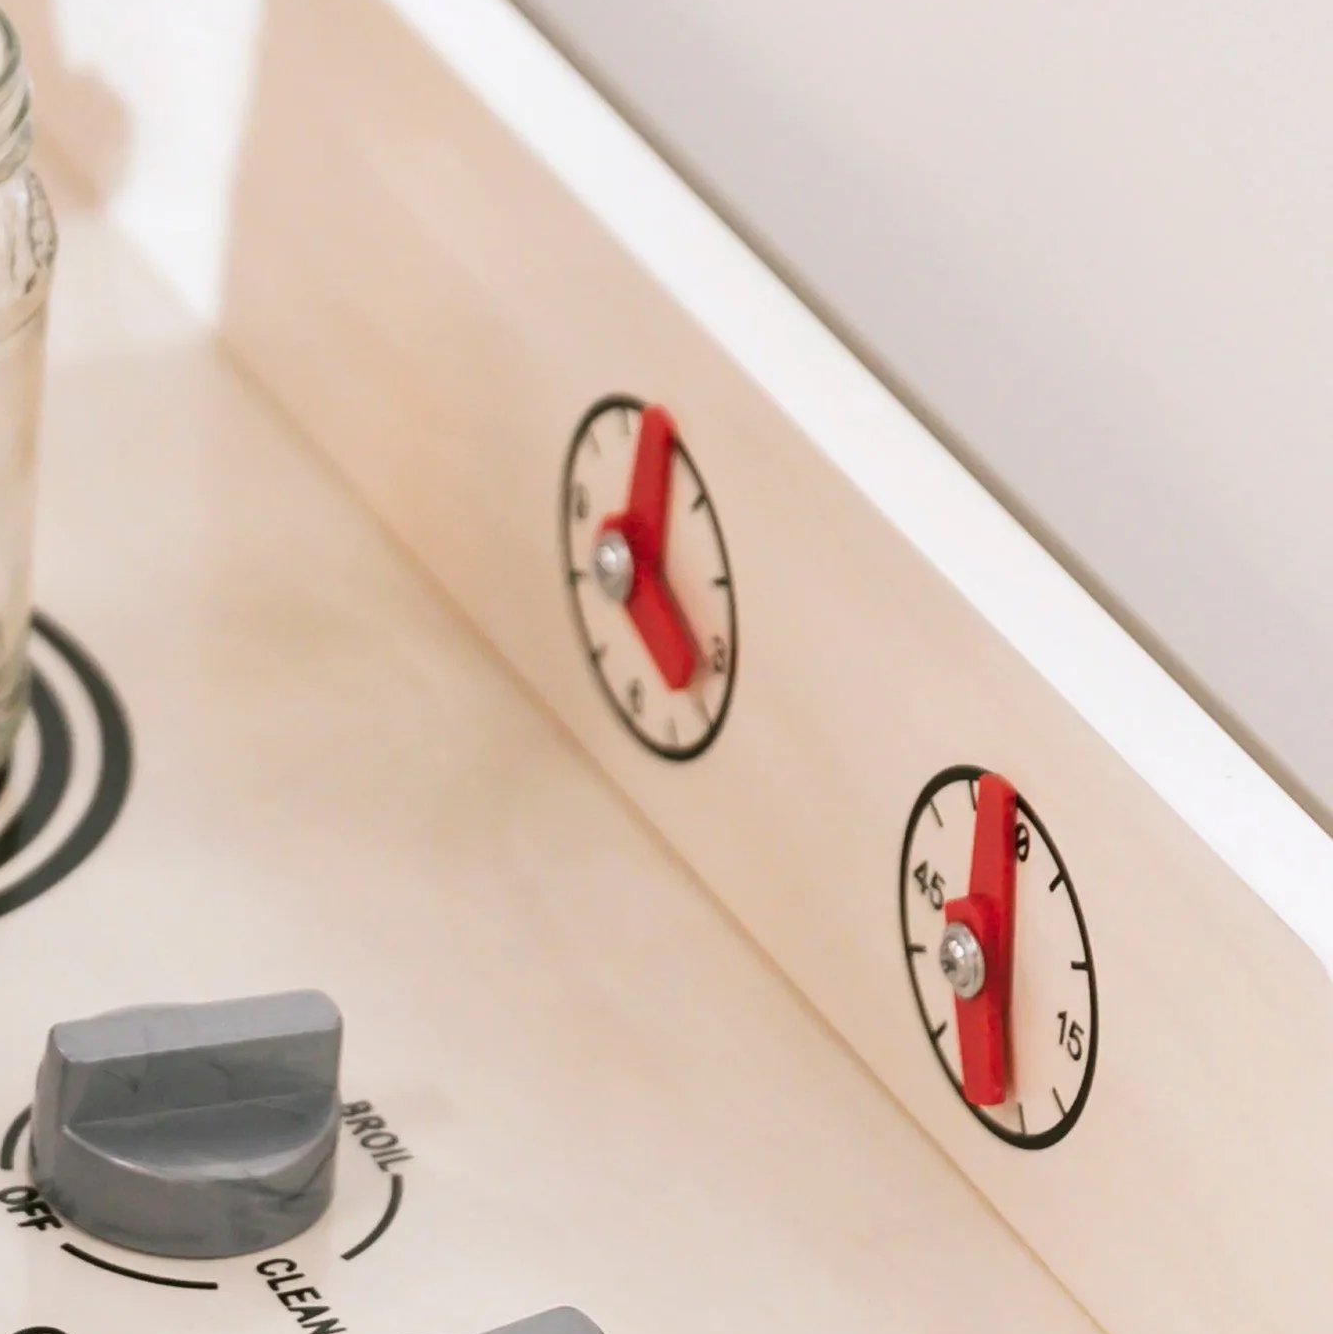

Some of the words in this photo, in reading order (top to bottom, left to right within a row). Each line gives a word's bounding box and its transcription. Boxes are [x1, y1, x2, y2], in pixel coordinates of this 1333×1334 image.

[914, 861, 945, 910] 45
[1057, 1011, 1085, 1061] 15
[341, 1100, 415, 1172] BROIL
